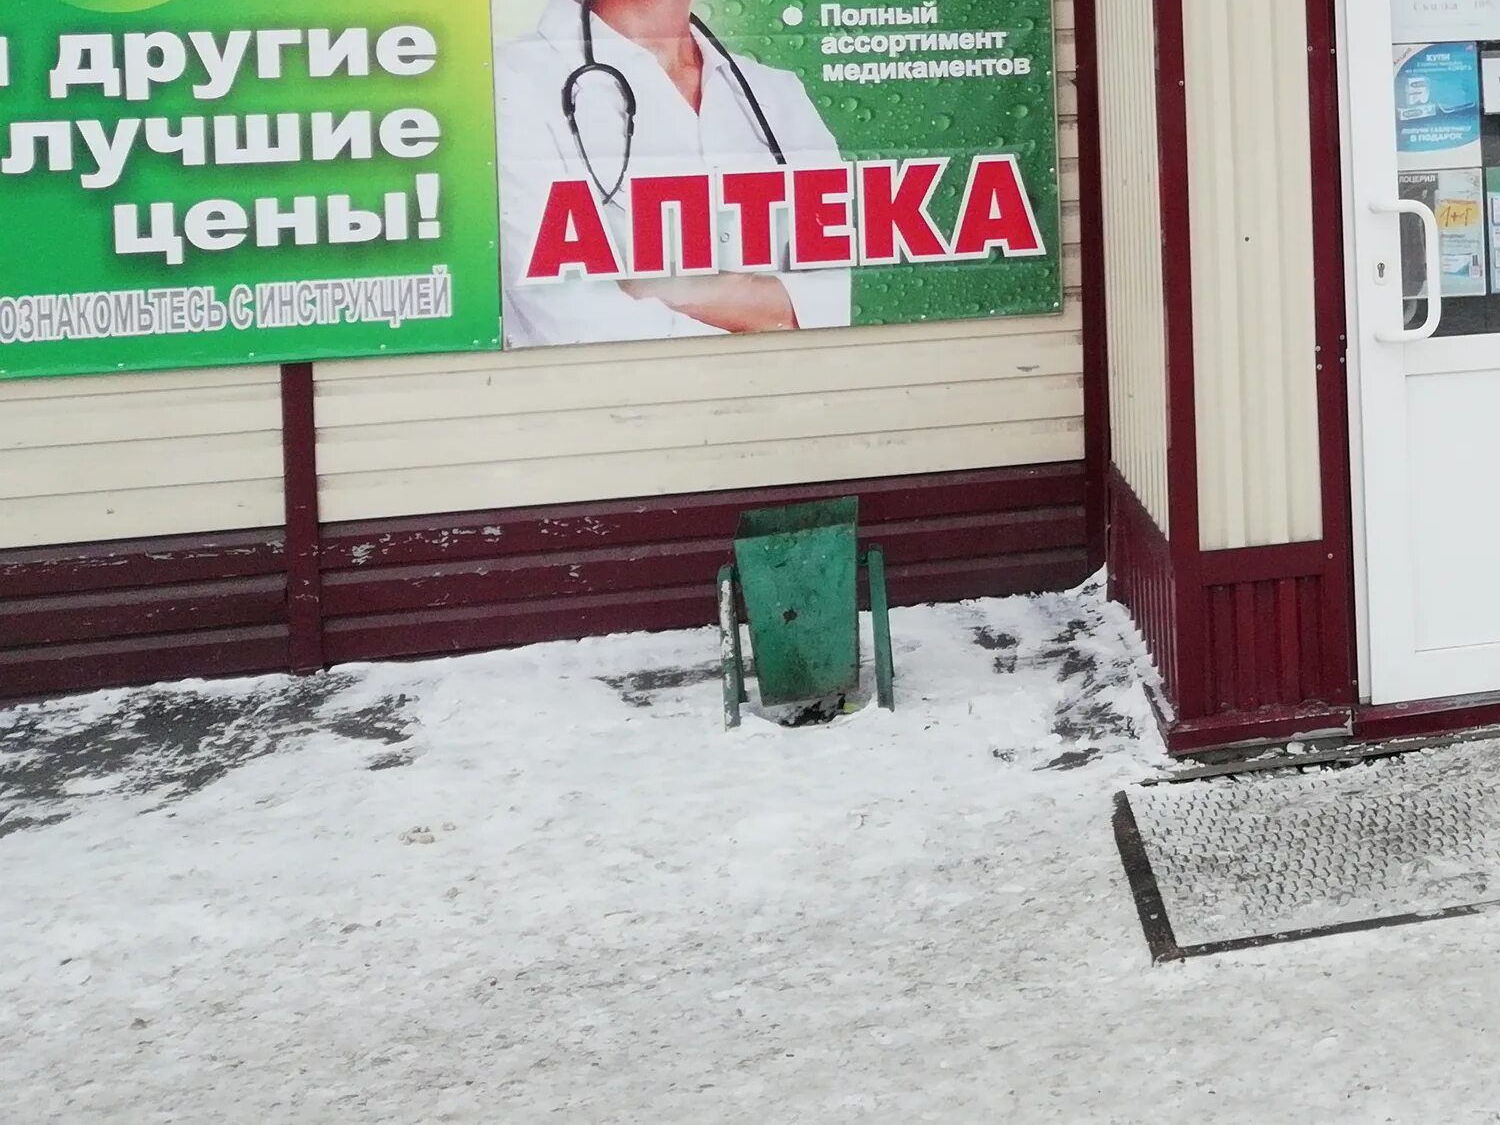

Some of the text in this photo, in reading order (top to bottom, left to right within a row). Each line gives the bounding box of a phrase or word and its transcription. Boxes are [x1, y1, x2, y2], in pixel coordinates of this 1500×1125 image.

[820, 0, 938, 27] Полный
[821, 31, 1008, 57] ассортимент
[49, 25, 438, 101] другие
[823, 58, 1031, 84] медикаментов
[0, 108, 441, 189] лучшие
[113, 173, 441, 265] цены!
[518, 154, 1045, 284] АПТЕКА
[0, 286, 227, 343] ОЗНАКОМЬТЕСЬ
[256, 264, 453, 328] ИНСТРУКЦИЕЙ
